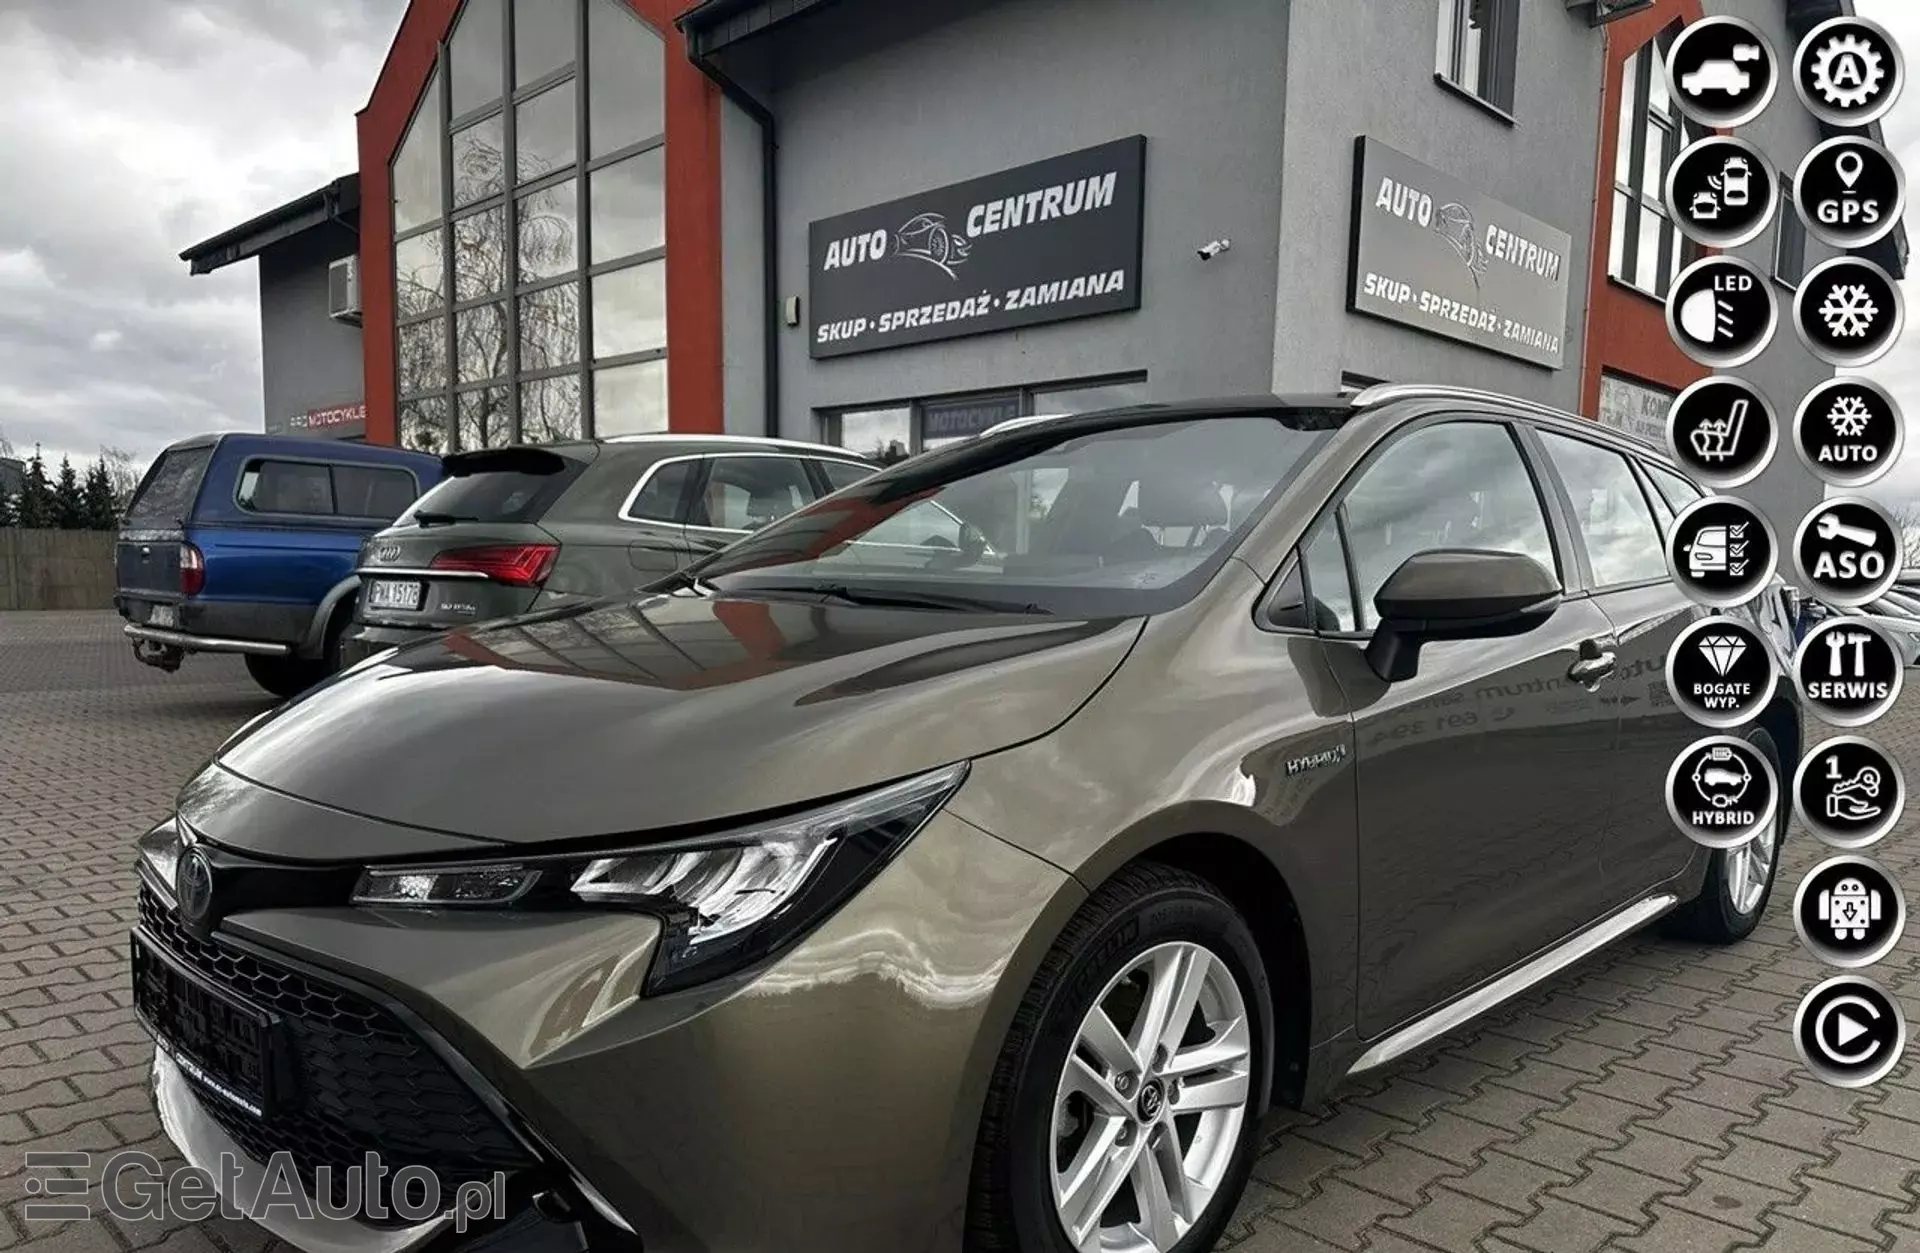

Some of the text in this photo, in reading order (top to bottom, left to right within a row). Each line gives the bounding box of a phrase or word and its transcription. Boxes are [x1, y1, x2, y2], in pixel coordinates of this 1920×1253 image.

[823, 171, 1117, 270] AUTO CENTRUM
[1375, 176, 1562, 282] AUTO CENTRUM
[816, 268, 1125, 343] SKUP SPRZEDAŻ ZAMIANA
[1363, 272, 1412, 304] SKUP
[1503, 319, 1560, 355] ZAMIANA
